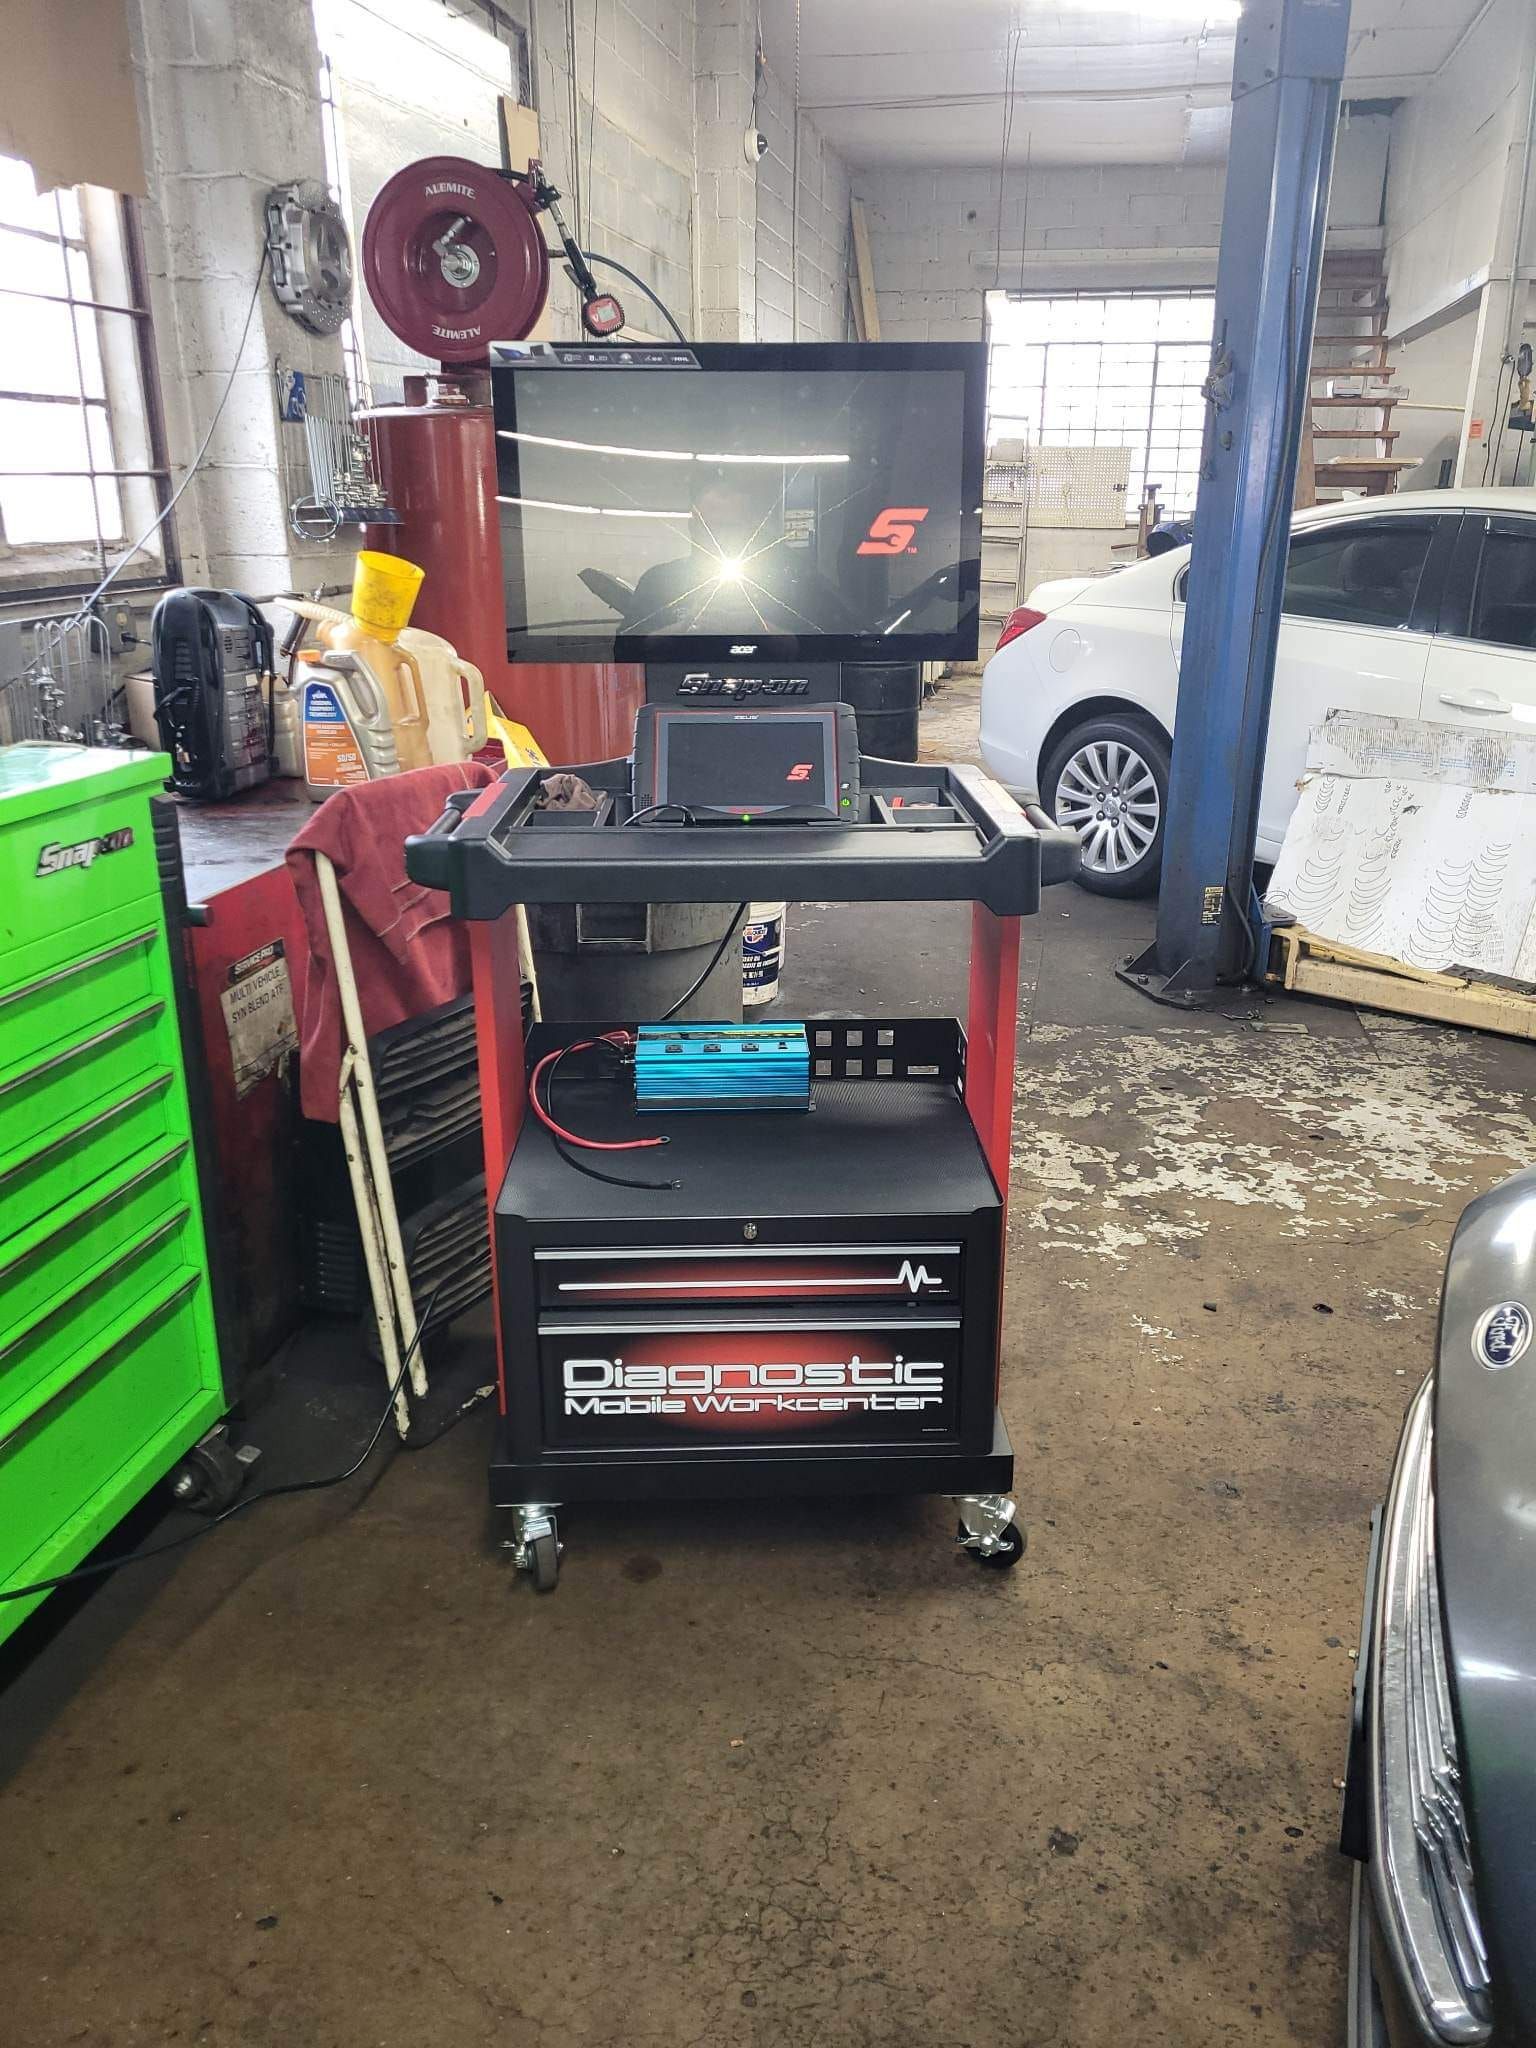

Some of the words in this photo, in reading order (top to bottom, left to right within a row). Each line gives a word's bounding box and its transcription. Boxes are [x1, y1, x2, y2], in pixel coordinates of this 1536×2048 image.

[425, 182, 477, 200] ALEMITE
[432, 324, 481, 340] ALEMITE
[729, 644, 758, 655] acer
[677, 672, 810, 700] Snap-on
[230, 983, 252, 1003] MULTI
[251, 966, 281, 990] VEHICLE
[232, 1006, 247, 1024] SYN
[247, 993, 269, 1014] BLEND
[1487, 1307, 1525, 1357] Ford
[563, 1355, 945, 1394] Diagnostic
[564, 1396, 687, 1416] Mobile
[692, 1394, 944, 1413] Workcenter
